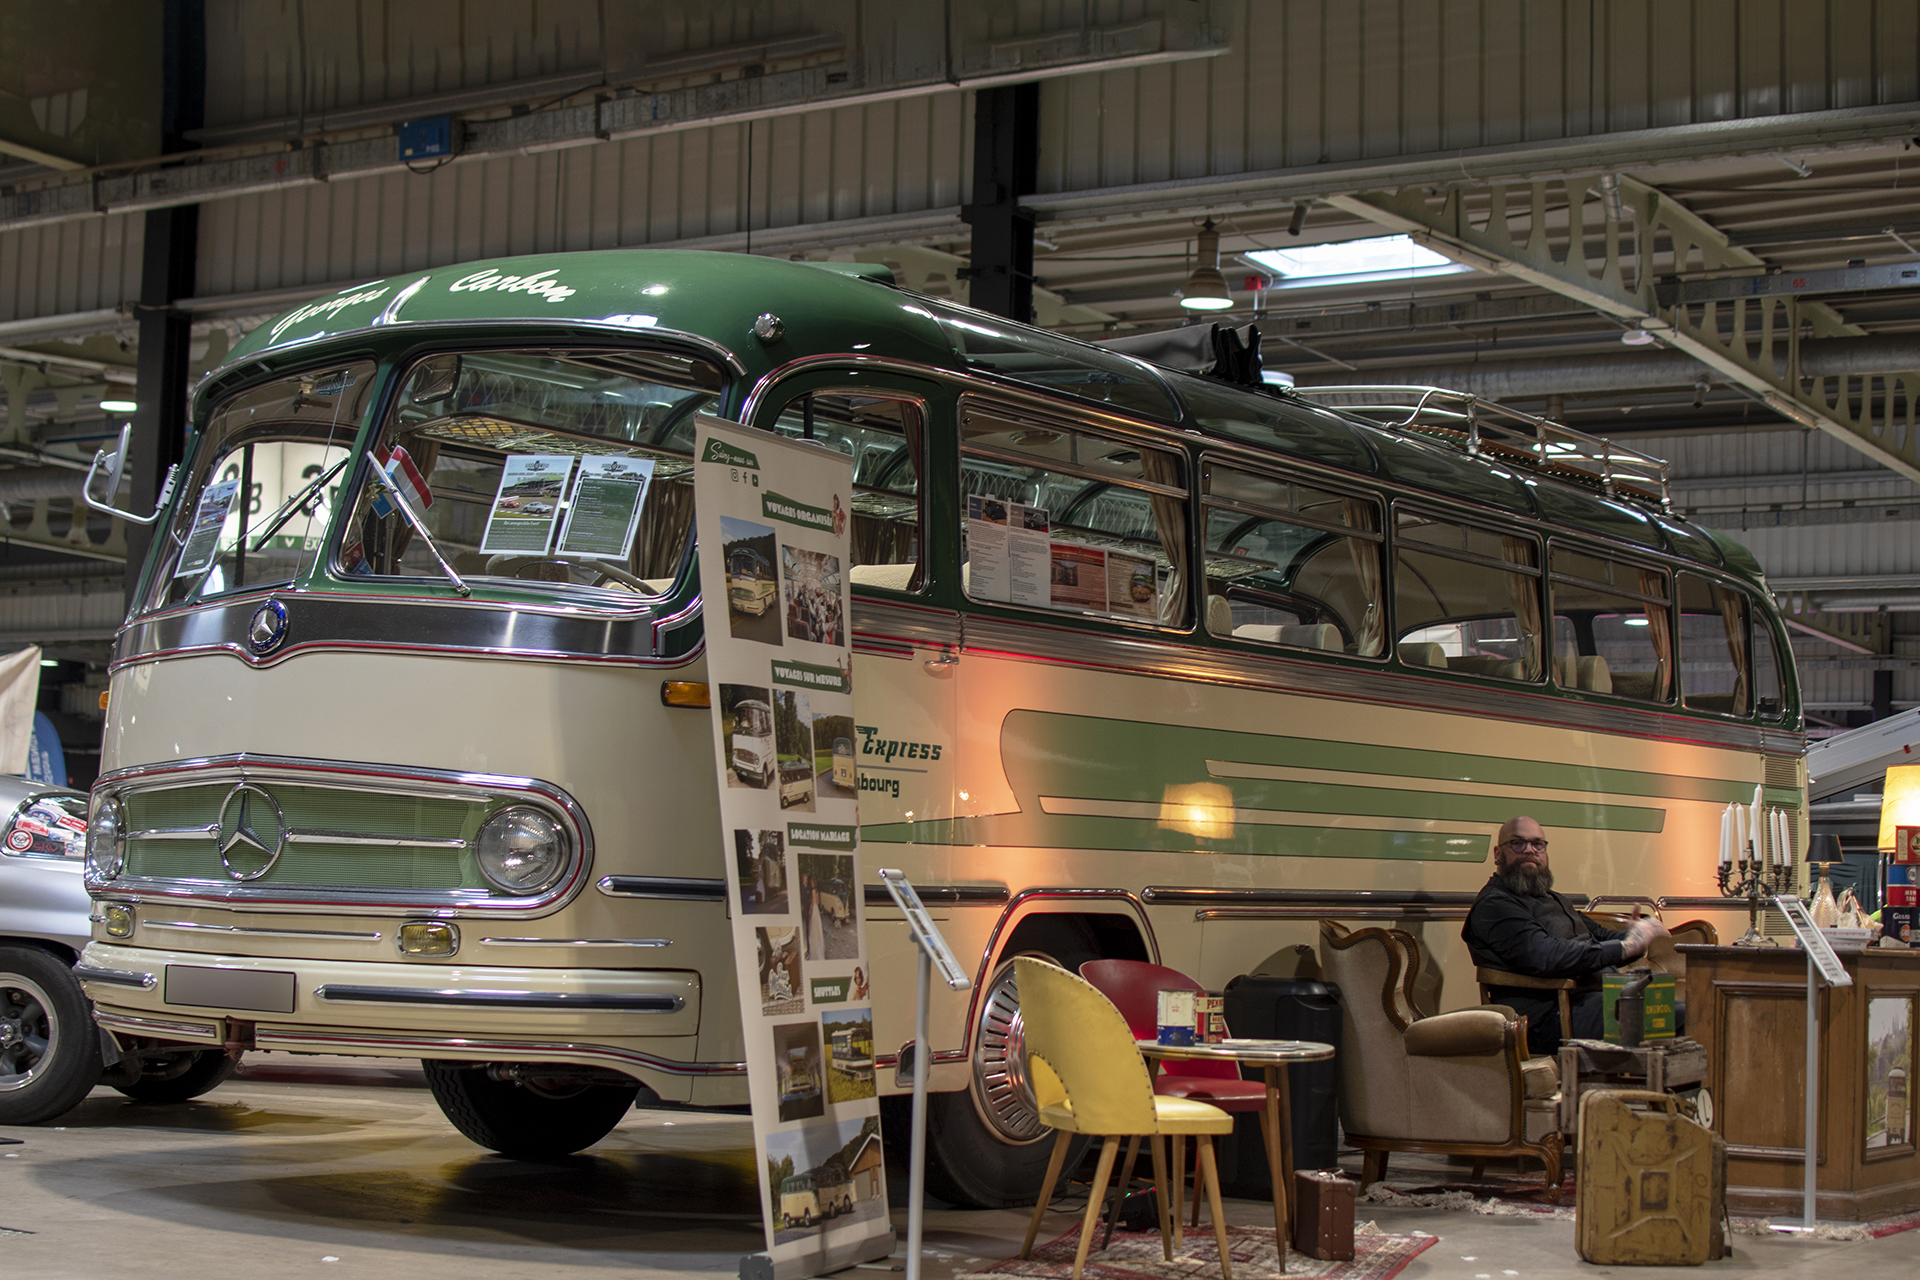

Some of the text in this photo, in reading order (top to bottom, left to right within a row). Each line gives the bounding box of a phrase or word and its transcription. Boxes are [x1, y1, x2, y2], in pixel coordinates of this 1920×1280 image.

[269, 286, 390, 345] Georges
[766, 501, 796, 519] VOYAGES
[774, 666, 842, 687] VOYAGES SUR MESURE
[855, 725, 942, 763] Express
[857, 773, 900, 798] bourg
[790, 828, 850, 842] LOCATION MARIAGE
[813, 985, 842, 998] SHUTTLES
